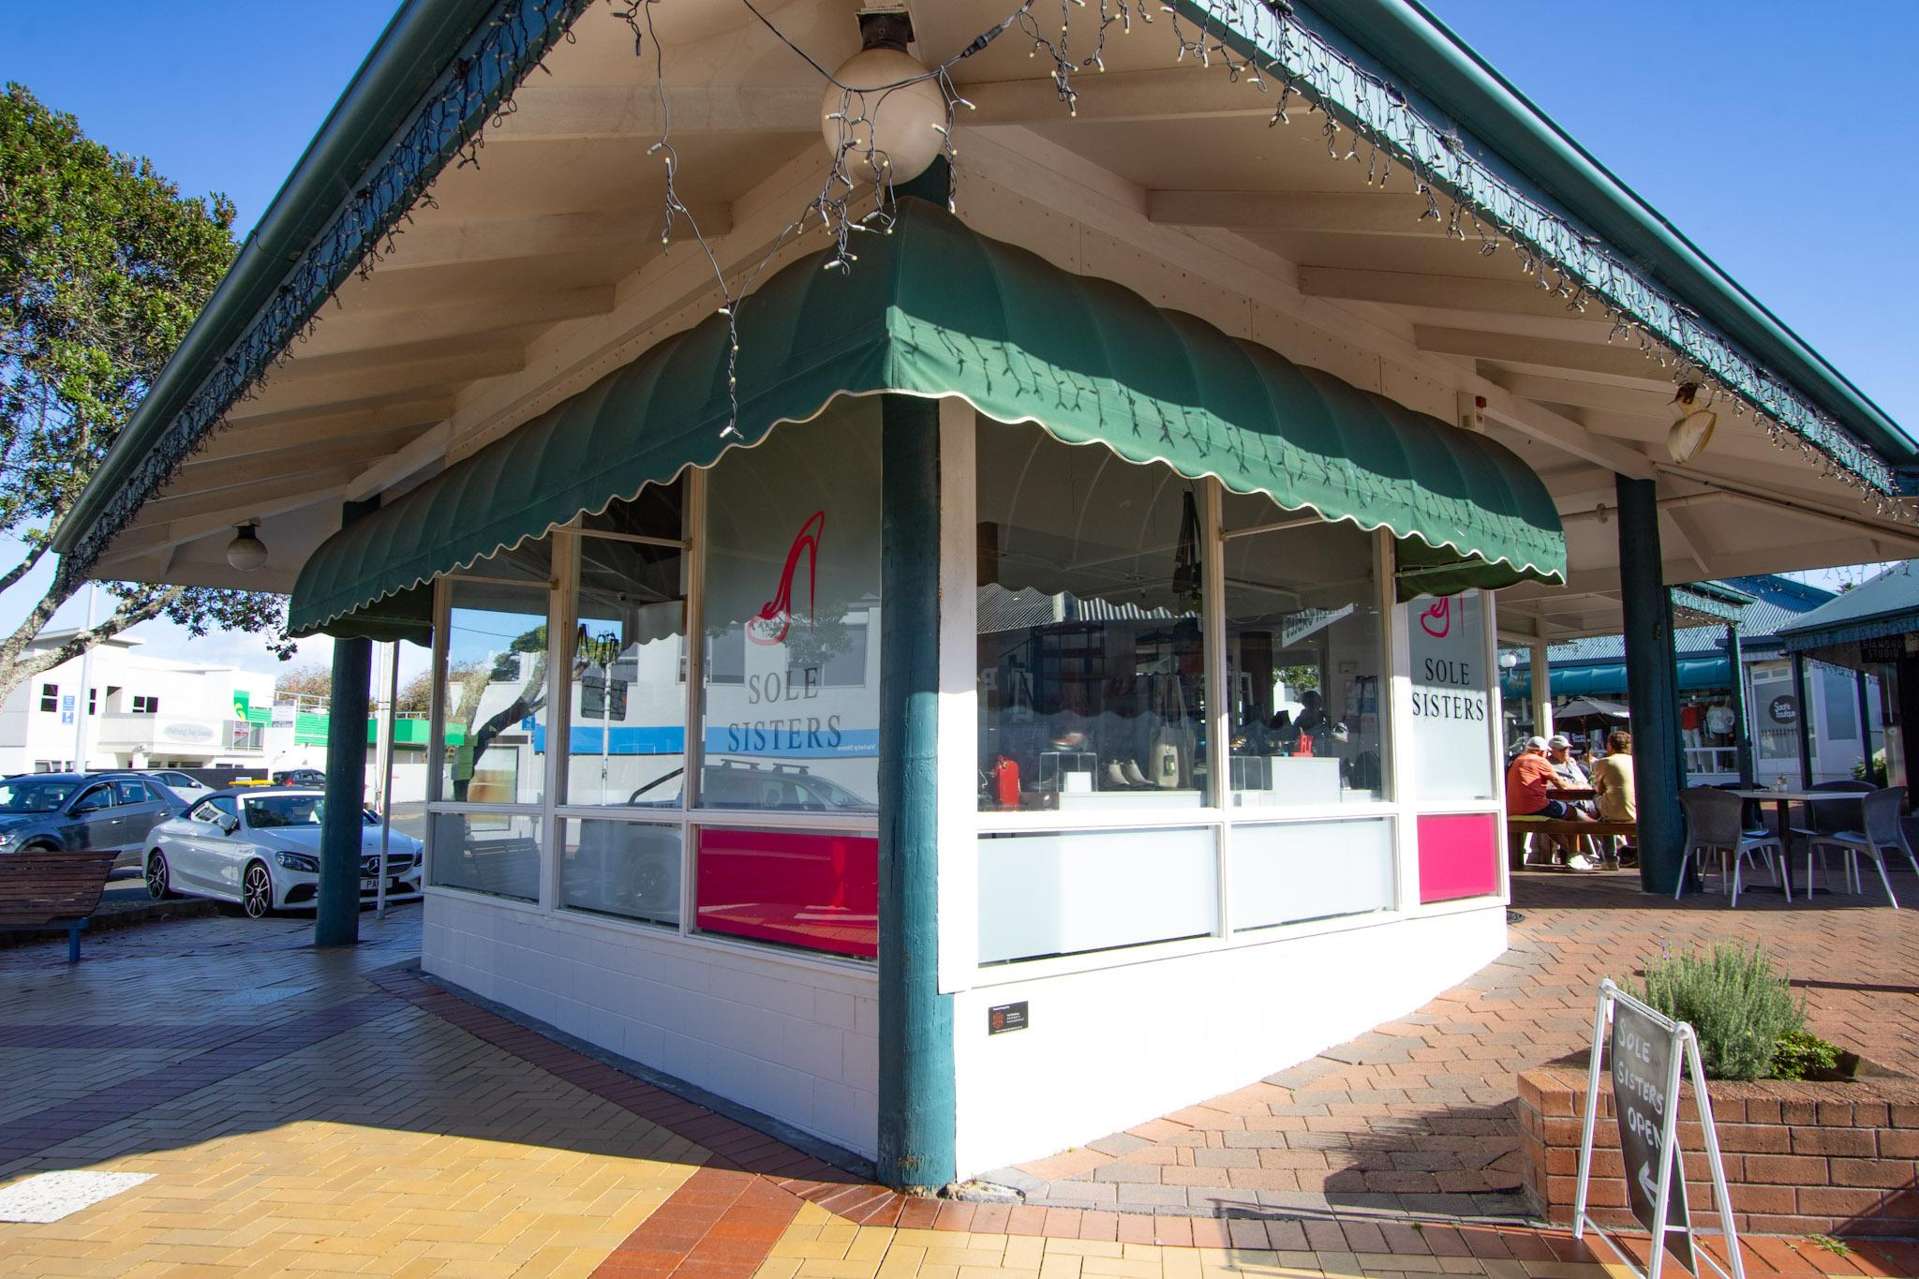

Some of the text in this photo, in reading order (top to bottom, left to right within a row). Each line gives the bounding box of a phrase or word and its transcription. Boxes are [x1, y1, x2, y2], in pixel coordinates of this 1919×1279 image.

[748, 667, 819, 704] SOLE
[1425, 657, 1470, 685] SOLE
[1412, 692, 1484, 721] SISTERS
[728, 714, 842, 752] SISTERS
[1617, 1018, 1651, 1064] SOLE
[1616, 1060, 1664, 1115] SISTERS
[1627, 1106, 1664, 1151] OPEN
